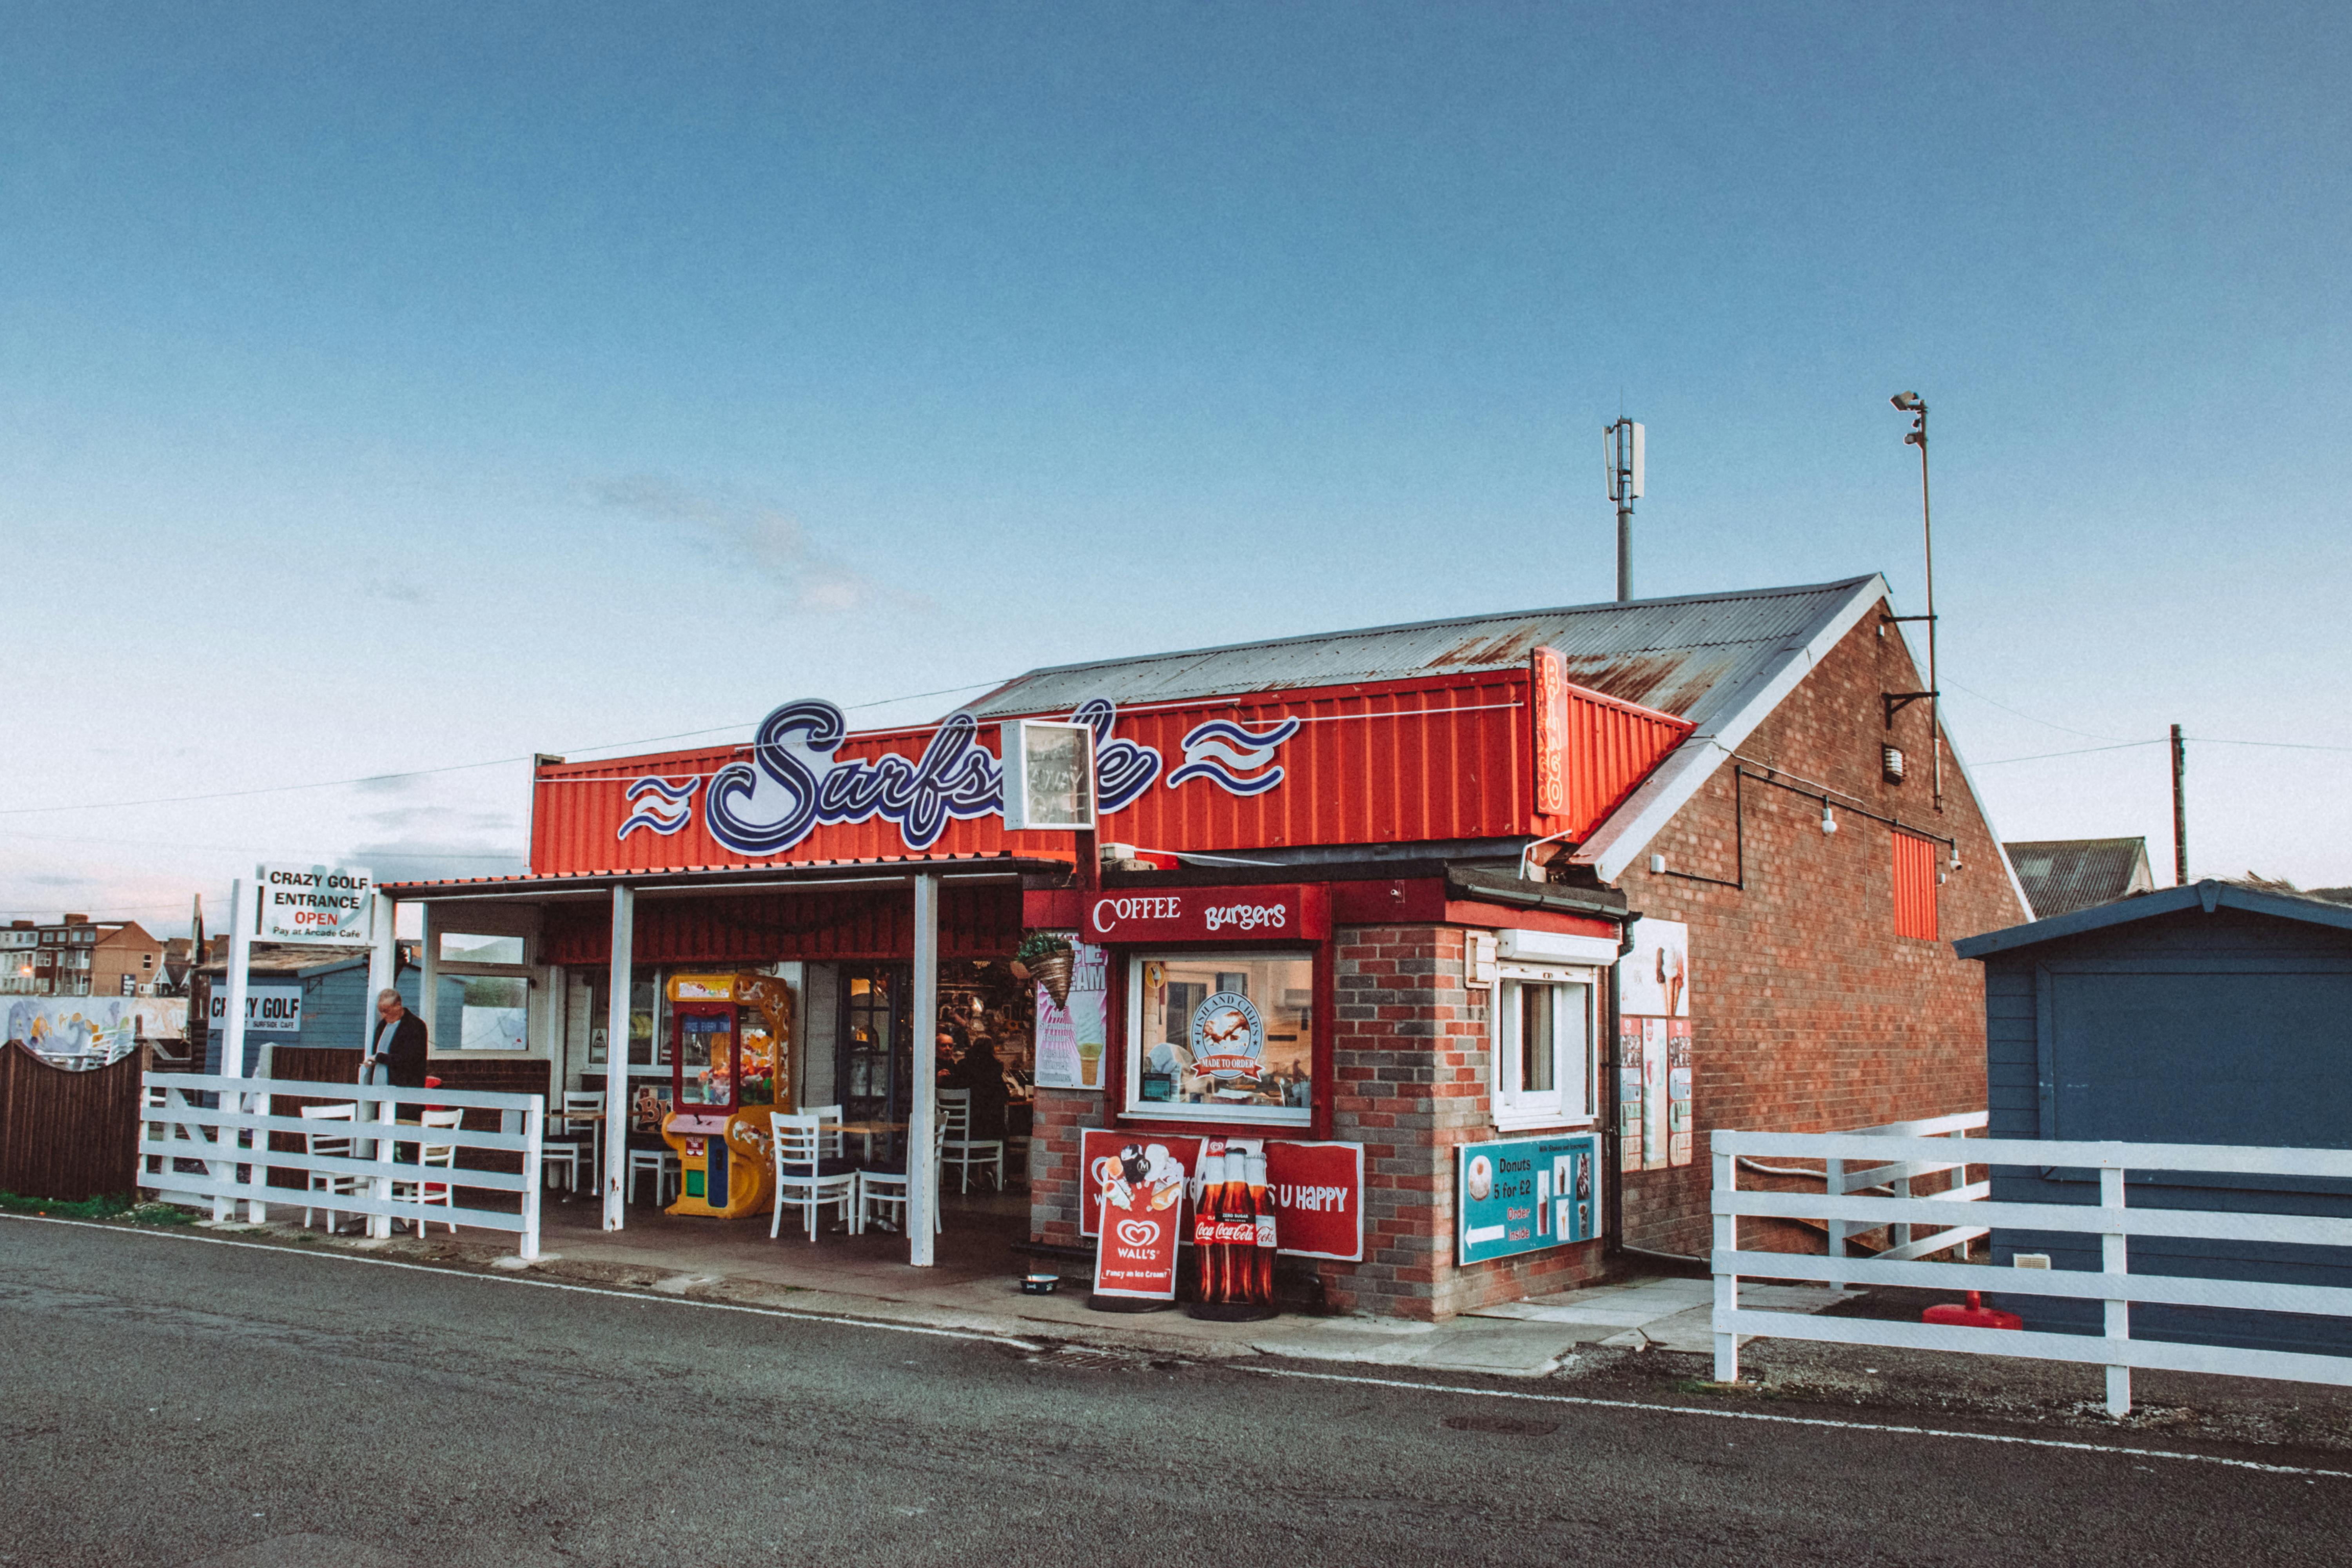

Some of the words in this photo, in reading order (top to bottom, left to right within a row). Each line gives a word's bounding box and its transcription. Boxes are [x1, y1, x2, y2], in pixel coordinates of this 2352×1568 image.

[706, 698, 1161, 857] Surfse
[270, 871, 322, 887] CRAZY
[328, 875, 368, 890] GOLF
[275, 892, 359, 909] ENTRANCE
[295, 911, 338, 926] OPEN
[1093, 897, 1181, 933] COFFEE
[273, 927, 289, 936] Pay
[305, 928, 337, 936] Arcade
[263, 998, 299, 1018] GOLF
[1195, 1006, 1210, 1035] FISH
[1212, 996, 1234, 1008] AND
[1238, 1000, 1259, 1036] CHIPS
[1202, 1059, 1220, 1067] MADE
[1222, 1059, 1230, 1068] TO
[1231, 1059, 1254, 1068] ORDER
[1499, 1158, 1530, 1173] Donuts
[1281, 1184, 1292, 1207] U
[1494, 1183, 1499, 1199] 5
[1503, 1182, 1517, 1198] for
[1519, 1179, 1530, 1195] £2
[1508, 1205, 1530, 1221] Order
[1118, 1247, 1156, 1260] WALL'S
[1106, 1269, 1125, 1279] Fancy
